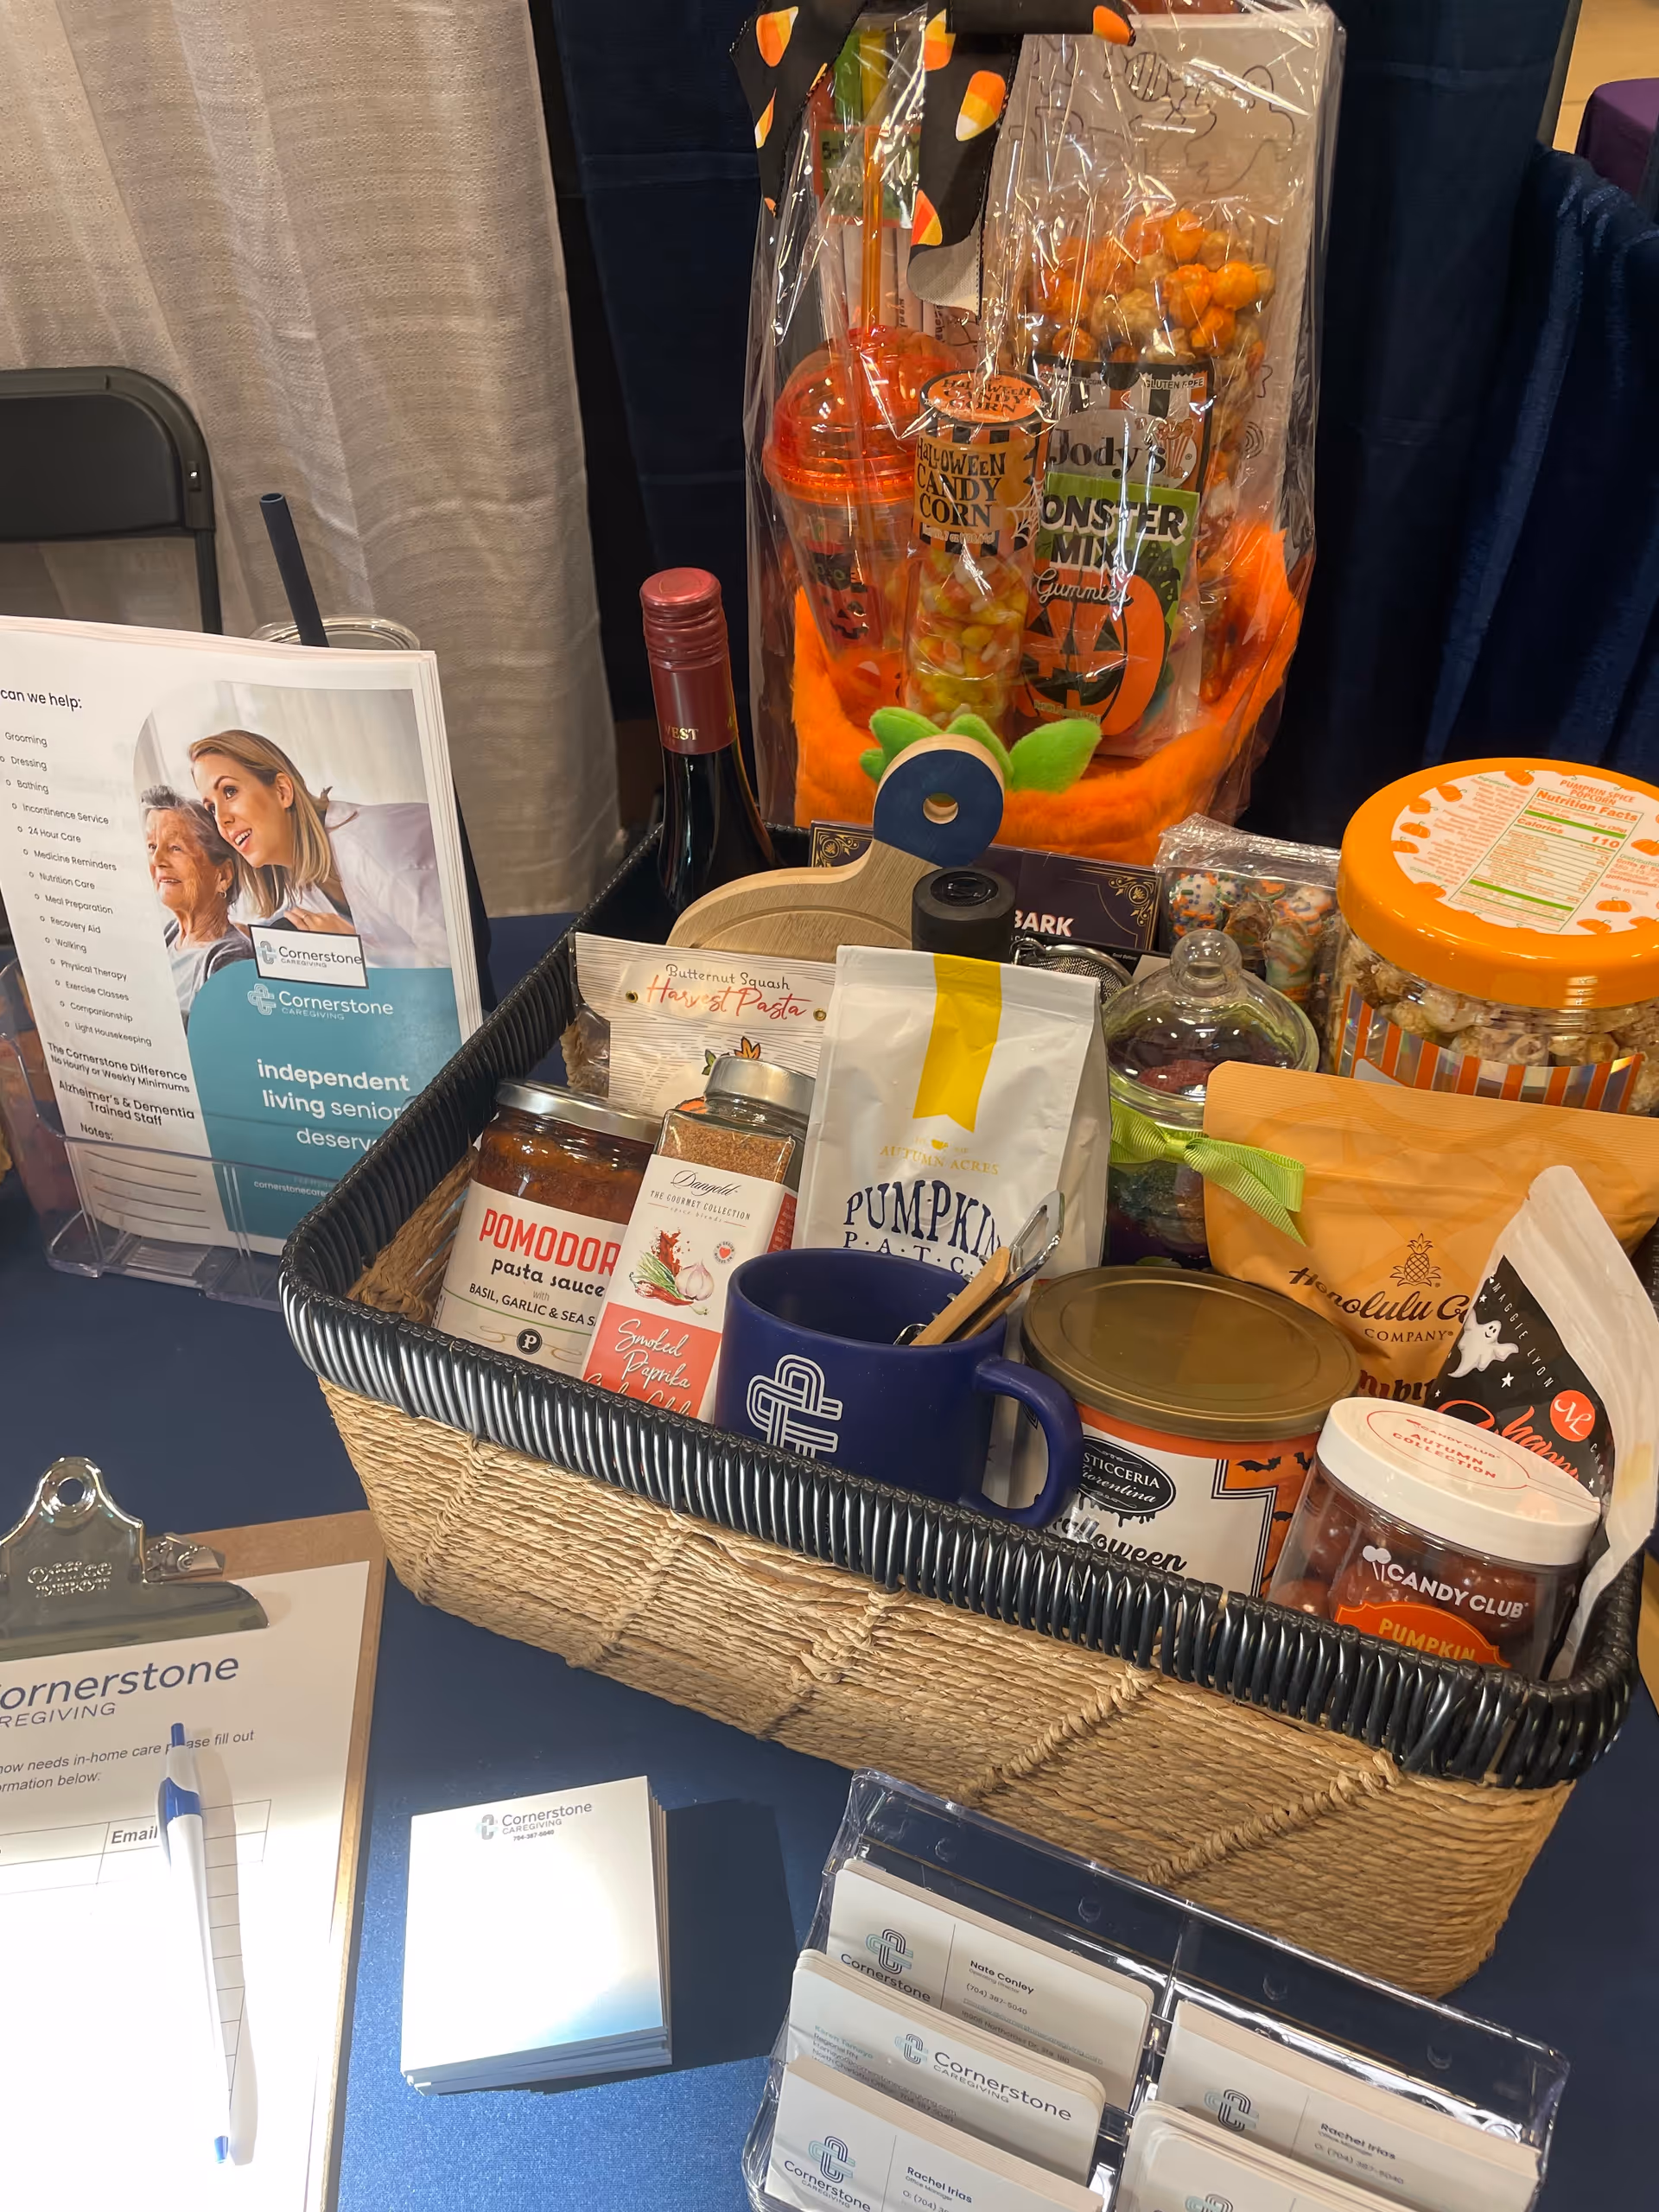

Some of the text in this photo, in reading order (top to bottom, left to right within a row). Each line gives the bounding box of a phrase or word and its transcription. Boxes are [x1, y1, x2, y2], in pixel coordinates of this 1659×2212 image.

[1144, 379, 1179, 389] GLUTEN
[1049, 429, 1166, 480] Jody's
[917, 463, 1002, 502] CANDY
[919, 493, 993, 528] CORN
[1040, 493, 1189, 546] ONSTER
[1050, 533, 1120, 574] MIX
[1033, 569, 1133, 607] Gummies
[0, 689, 83, 712] can we help:
[5, 731, 48, 748] Grooming
[10, 755, 48, 772] Dressing
[16, 779, 49, 795] Bathing
[1559, 779, 1637, 804] PUMPKIN SPICE
[1569, 789, 1618, 806] POPCORN
[22, 803, 110, 824] Incontinence Service
[1536, 790, 1597, 813] Nutrition
[1599, 806, 1639, 823] Facts
[28, 826, 82, 843] 24 Hour Care
[1516, 817, 1565, 836] Calories
[1591, 836, 1621, 849] 110
[34, 849, 118, 872] Medicine Reminders
[39, 872, 95, 890] Nutrition Care
[44, 894, 114, 915] Meal Preparation
[49, 916, 102, 934] Recovery Aid
[55, 938, 87, 954] Walking
[278, 945, 363, 966] Cornerstone
[60, 959, 128, 982] Physical Therapy
[280, 957, 328, 969] CAREGIVING
[665, 963, 791, 991] Butternut Squash
[65, 981, 130, 1001] Exercise Classes
[278, 990, 395, 1016] Cornerstone
[646, 975, 813, 1020] Harvest Pasta
[70, 1002, 133, 1024] Companionship
[281, 1006, 346, 1021] CAREGIVING
[74, 1022, 153, 1047] Light Housekeeping
[48, 1041, 188, 1082] The Cornerstone Difference
[50, 1054, 191, 1094] No Hourly or Weekly Minimums
[257, 1058, 410, 1092] independent
[59, 1080, 196, 1120] Alzheimer's & Dementia
[87, 1101, 162, 1127] Trained Staff
[262, 1089, 327, 1120] living
[79, 1122, 115, 1141] Notes:
[880, 1145, 1000, 1176] AUTUMN ACRES
[253, 1180, 329, 1198] cornerstonecare
[671, 1169, 743, 1198] Dangold
[650, 1190, 752, 1221] THE GOURMET COLLECTION
[842, 1179, 1001, 1258] PUMPKIN
[479, 1208, 622, 1278] POMODOR
[490, 1258, 606, 1298] pasta sauce
[469, 1282, 499, 1305] BASIL,
[501, 1294, 548, 1317] GARLIC
[548, 1306, 559, 1319] &
[560, 1310, 586, 1325] SEA
[532, 1290, 550, 1302] with
[1288, 1267, 1433, 1322] Honolulu
[614, 1318, 690, 1357] Smoked
[1491, 1282, 1554, 1389] MAGGIE LYON
[621, 1348, 692, 1390] Paprika
[1392, 1432, 1497, 1479] COLLECTION
[1410, 1433, 1484, 1466] AUTUMN
[1421, 1425, 1496, 1459] CANDY CLUB
[1083, 1452, 1160, 1490] STICCERIA
[1387, 1563, 1524, 1618] CANDY CLUB
[1378, 1618, 1476, 1661] PUMPKIN
[0, 1657, 239, 1710] ornerstone
[28, 1756, 69, 1771] needs
[73, 1749, 128, 1767] in-home
[131, 1744, 162, 1757] care
[165, 1738, 210, 1756] pase
[214, 1733, 229, 1745] fill
[232, 1730, 255, 1743] out
[57, 1771, 101, 1787] below:
[502, 1803, 593, 1827] Cornerstone
[502, 1818, 563, 1835] CAREGIVING
[111, 1826, 158, 1845] Email
[841, 1953, 931, 2003] Cornerstone
[969, 1960, 1035, 1995] Nate Conley
[965, 1982, 1028, 2016] (704) 387-5040
[812, 2048, 835, 2065] North
[813, 2032, 845, 2055] Regional
[845, 2048, 859, 2062] RN
[841, 2037, 874, 2061] Tamayo
[933, 2064, 1009, 2103] CAREGIVING
[934, 2051, 1072, 2121] Cornerstone
[1320, 2123, 1396, 2160] Rachel Irias
[784, 2159, 871, 2212] Cornerstone
[801, 2179, 851, 2209] CAREGIVING
[905, 2176, 953, 2202] Office Manager
[906, 2166, 973, 2204] Rachel Irias
[912, 2191, 938, 2211] (704)
